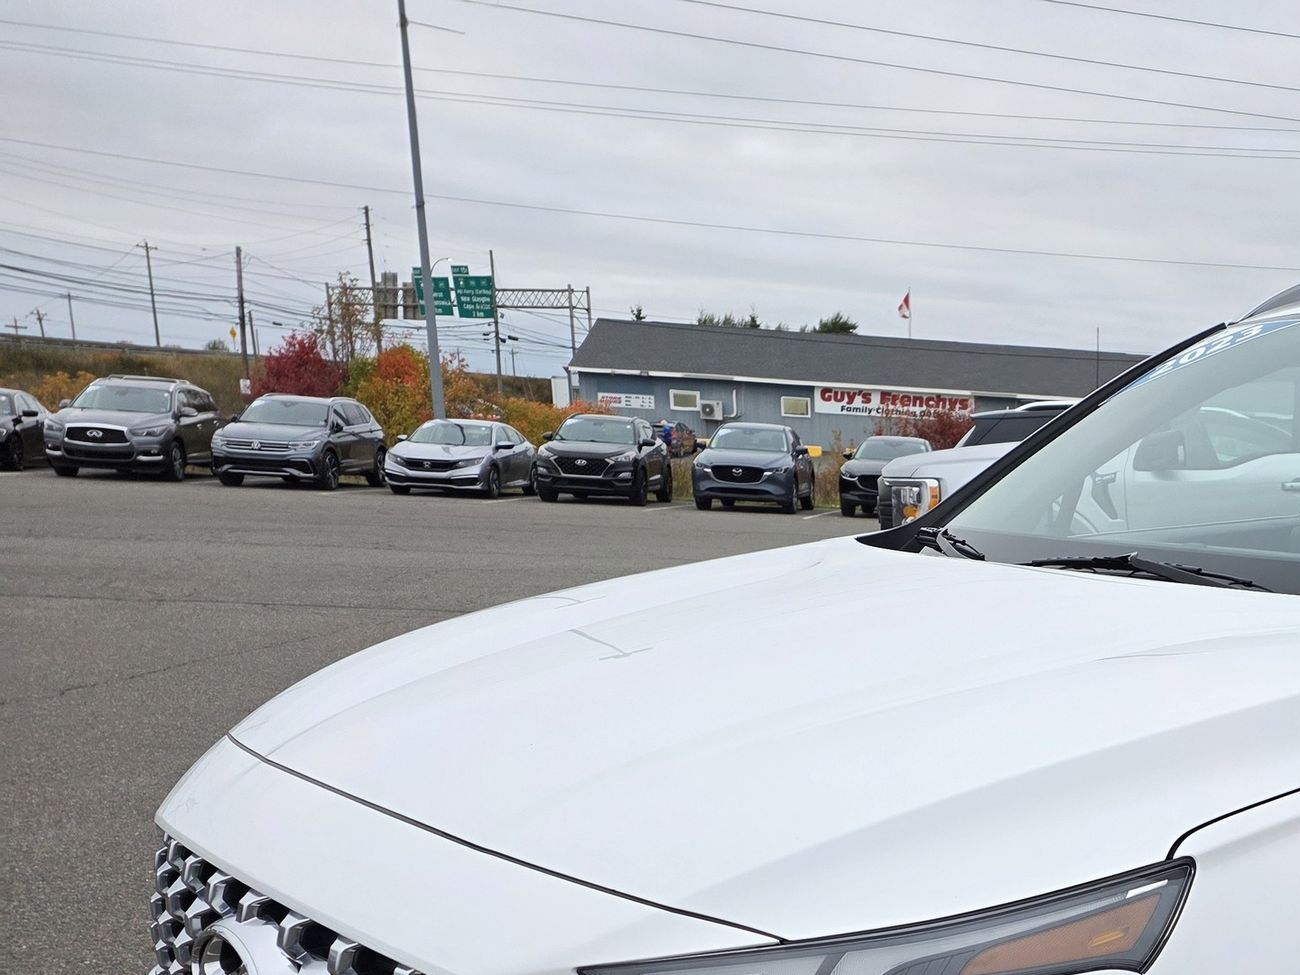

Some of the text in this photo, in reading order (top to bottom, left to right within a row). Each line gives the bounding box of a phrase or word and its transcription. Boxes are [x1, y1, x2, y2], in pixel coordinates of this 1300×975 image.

[1150, 324, 1264, 378] 2023
[820, 386, 969, 411] Guy's Frenchys
[841, 405, 873, 415] Family
